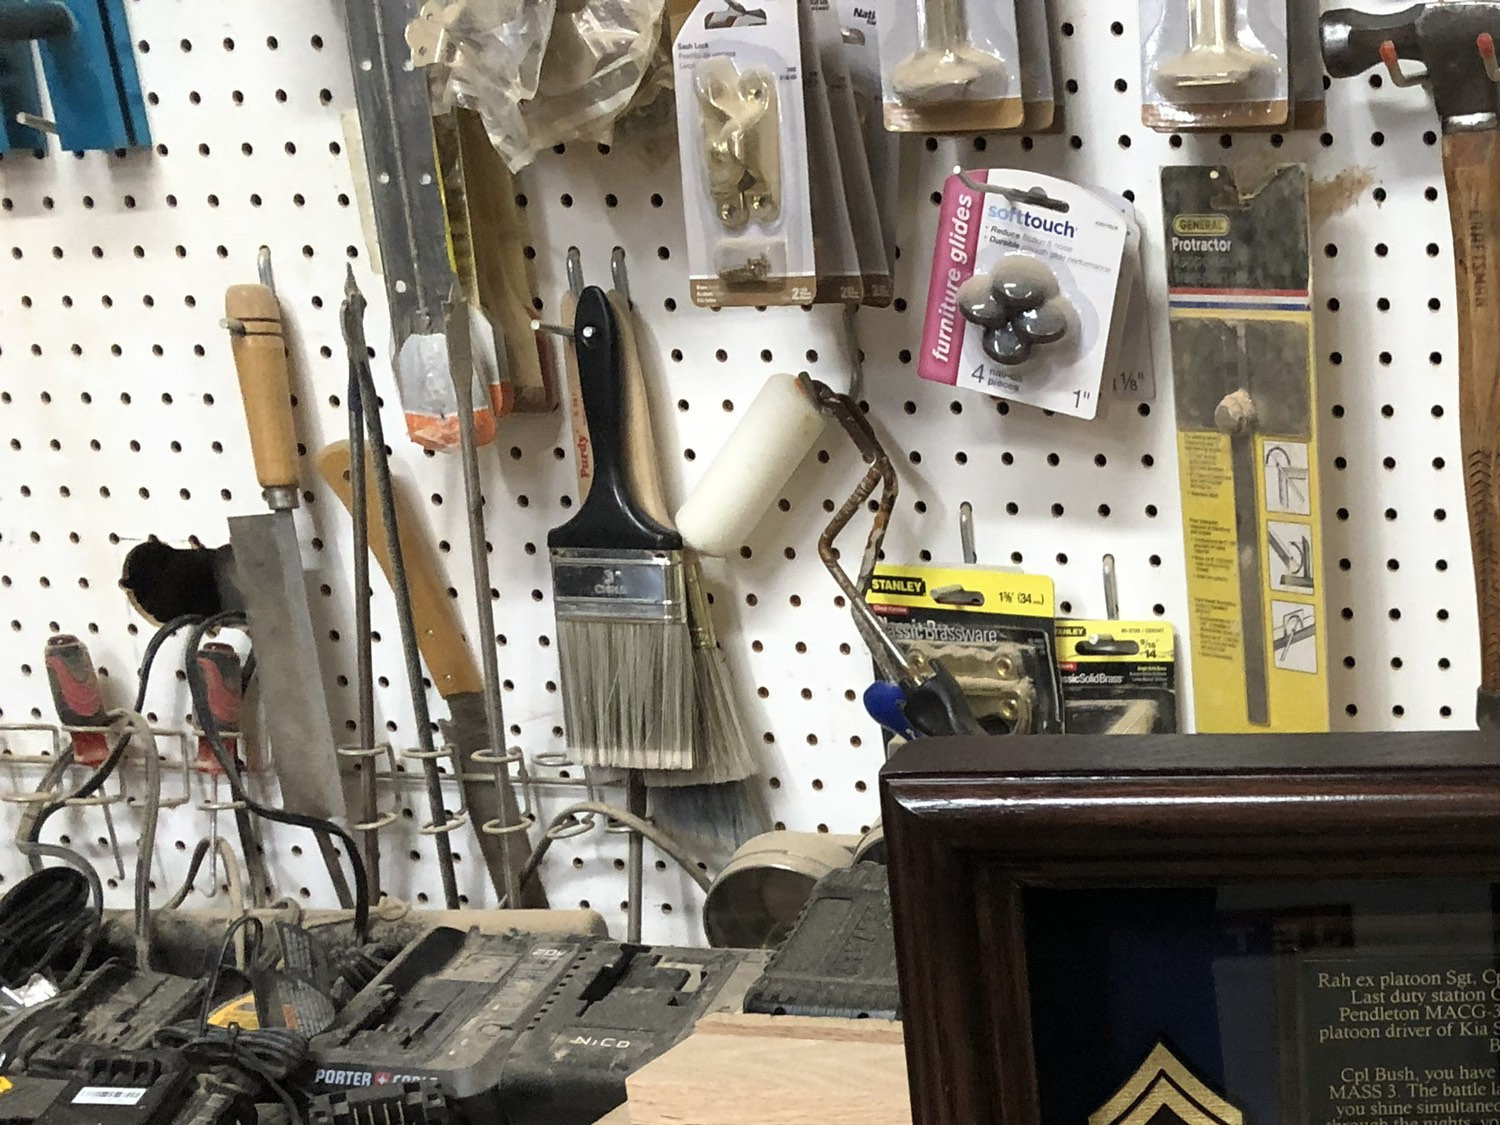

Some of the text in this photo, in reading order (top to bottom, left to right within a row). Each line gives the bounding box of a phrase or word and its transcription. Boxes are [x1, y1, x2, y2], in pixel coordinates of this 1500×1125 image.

[988, 204, 1075, 238] softtouch
[1180, 219, 1223, 230] GENERAL
[990, 226, 1021, 239] Reduce
[989, 235, 1021, 249] Durable
[1172, 237, 1231, 251] Protractor
[932, 194, 972, 363] furniture glides
[971, 364, 985, 383] 4
[987, 378, 1020, 392] pieces
[577, 435, 590, 478] Purdy
[872, 579, 922, 592] STANLEY
[1056, 627, 1084, 635] TANLEY
[1144, 649, 1157, 658] 14
[1317, 972, 1351, 987] Rah
[1355, 976, 1374, 986] ex
[1380, 970, 1441, 989] platoon
[1446, 969, 1476, 988] Sgt,
[1351, 988, 1385, 1003] Last
[1390, 988, 1426, 1006] duty
[1431, 986, 1486, 1002] station
[1339, 1005, 1419, 1021] Pendleton
[1319, 1023, 1380, 1043] platoon
[1385, 1022, 1432, 1037] driver
[1436, 1021, 1452, 1036] of
[1459, 1021, 1488, 1036] Kia
[315, 1069, 372, 1086] PORTER
[1340, 1067, 1369, 1085] Cpl
[1375, 1066, 1419, 1083] Bush,
[1424, 1069, 1454, 1084] you
[1459, 1065, 1496, 1079] have
[1335, 1105, 1365, 1119] you
[1370, 1100, 1412, 1115] shine
